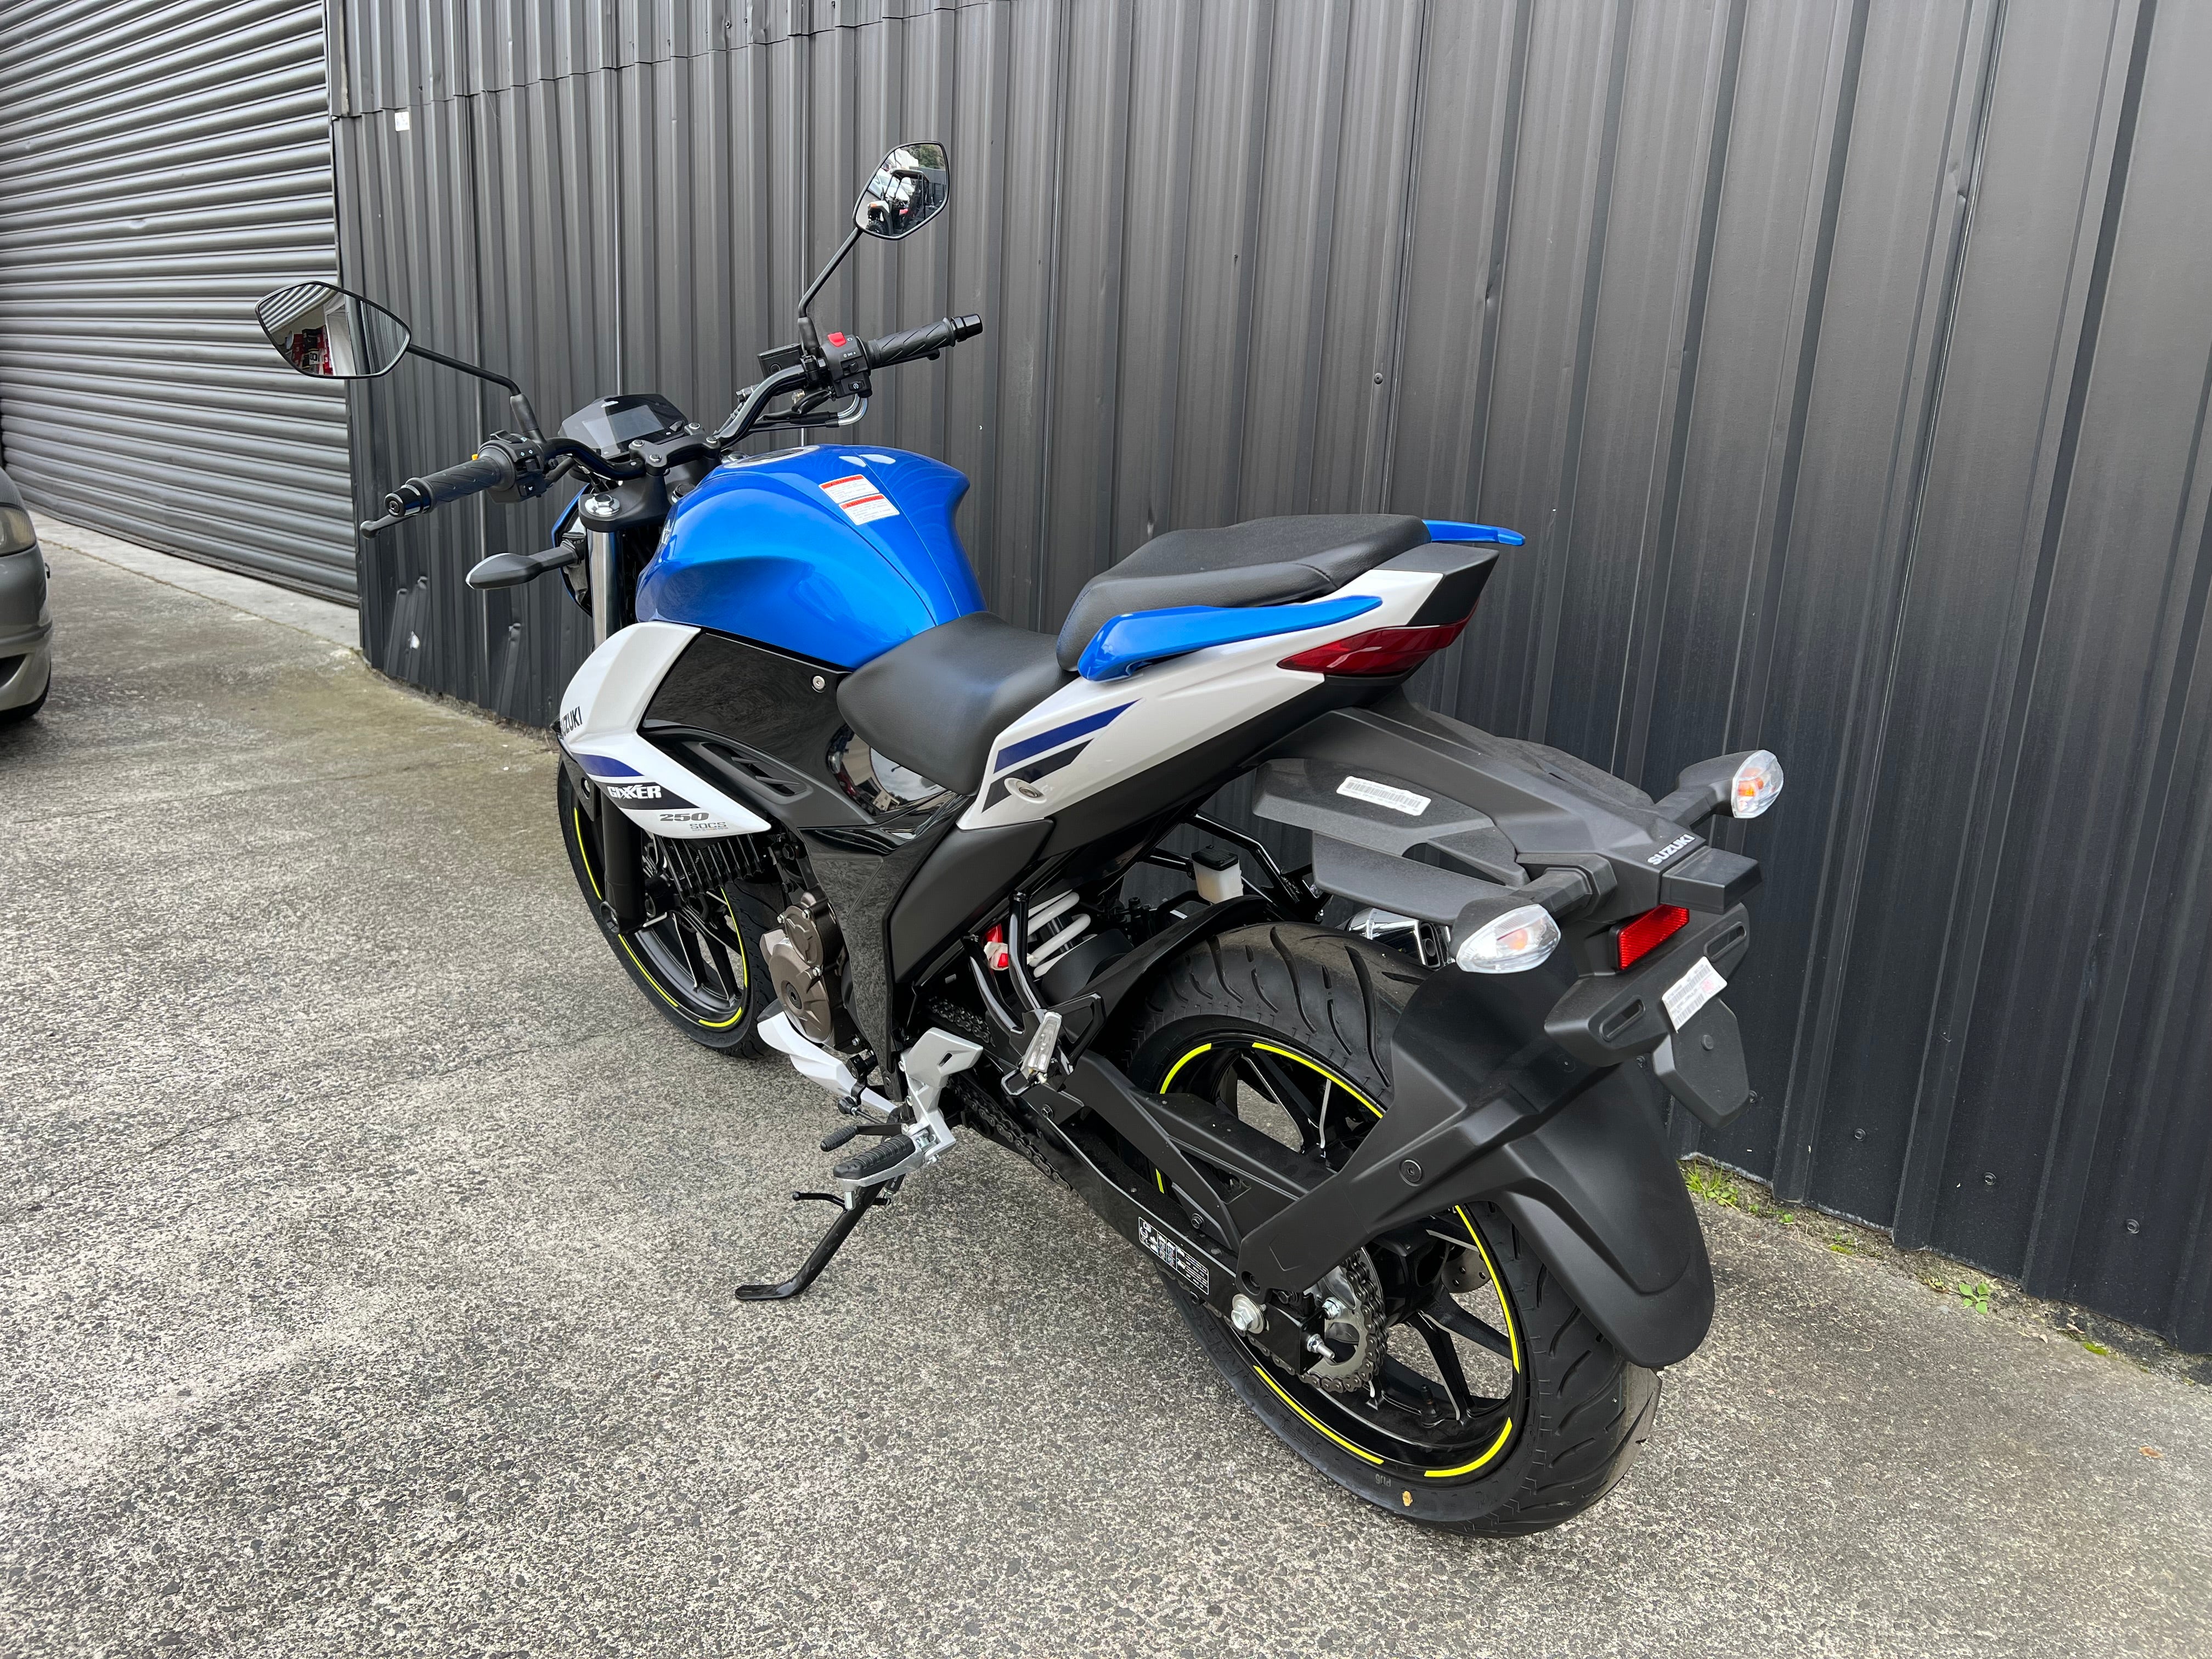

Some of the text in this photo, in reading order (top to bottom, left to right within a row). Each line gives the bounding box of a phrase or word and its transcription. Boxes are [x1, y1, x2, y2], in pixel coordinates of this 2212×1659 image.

[607, 784, 662, 799] GIXXER
[659, 812, 709, 821] 250
[1647, 834, 1696, 865] SUZUKI
